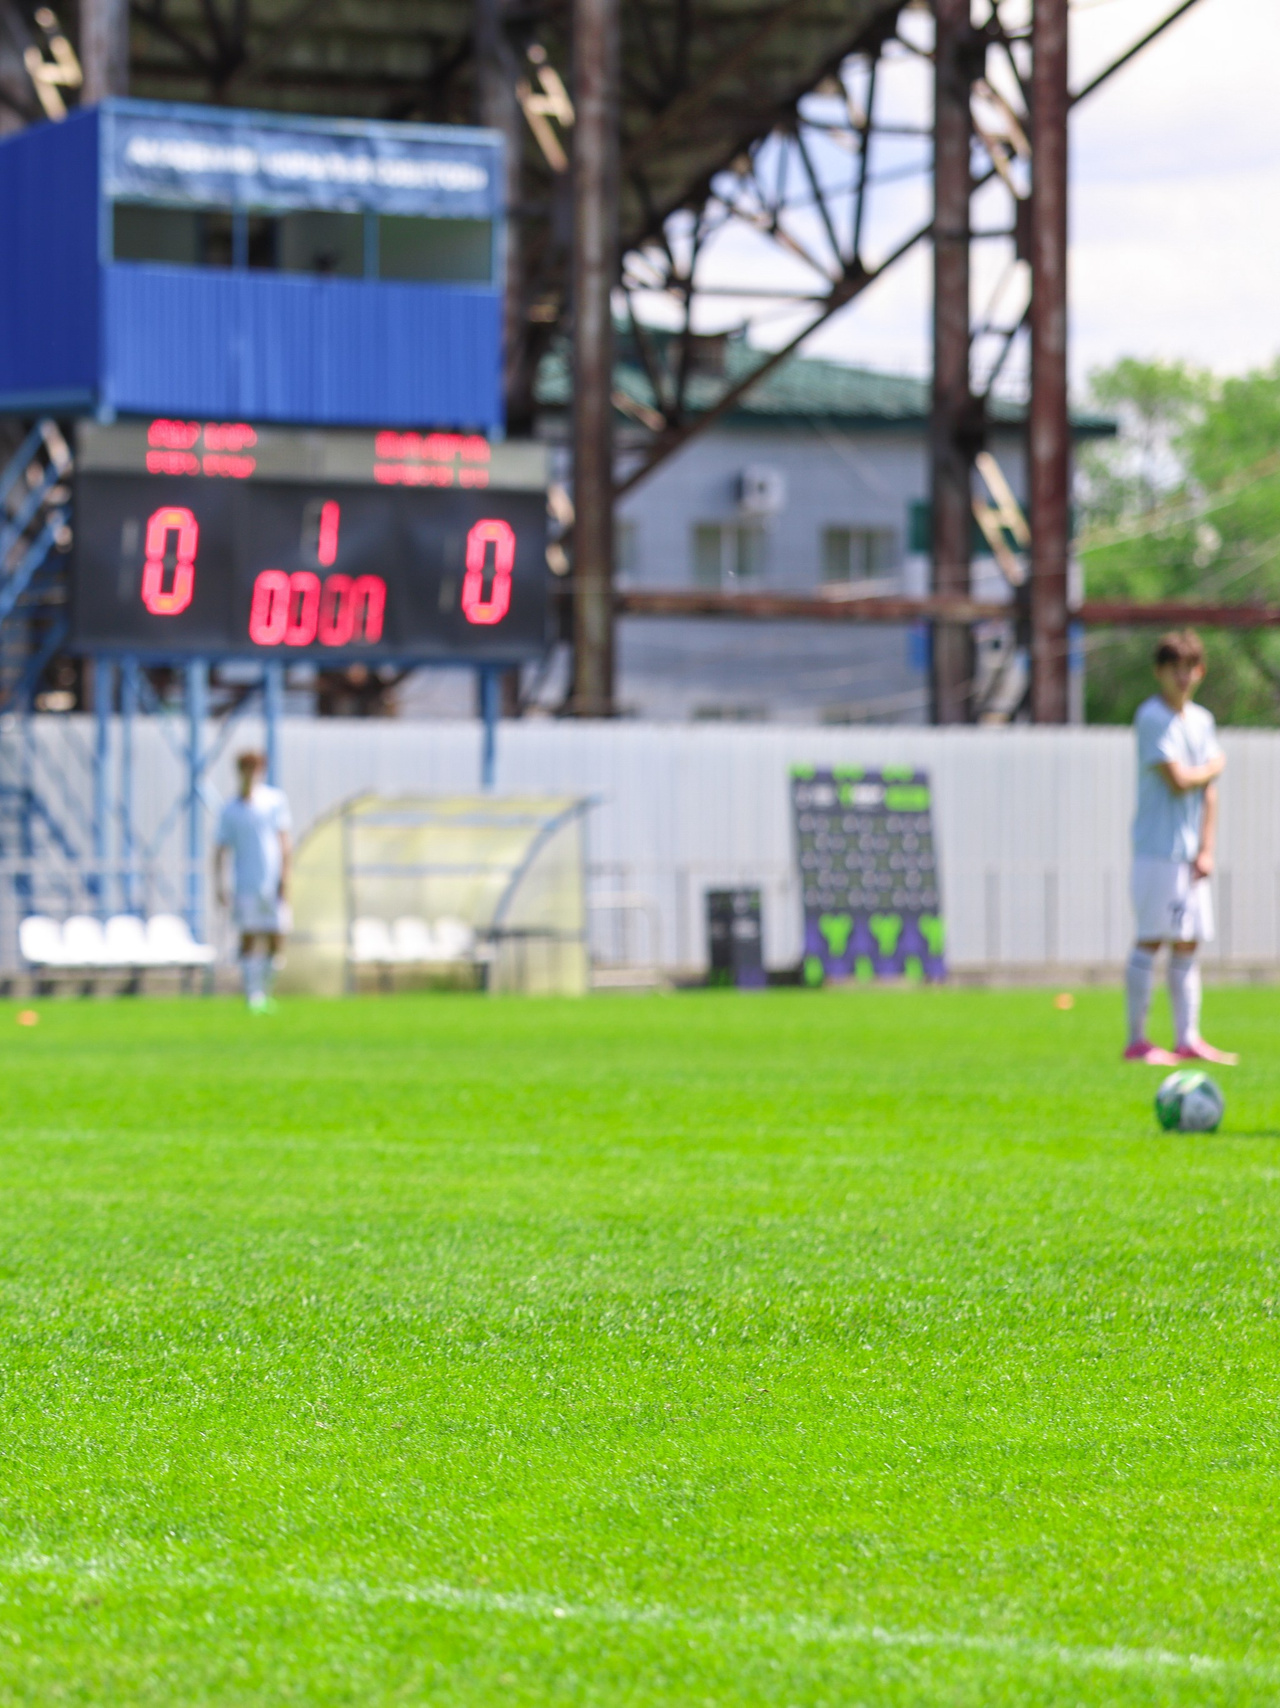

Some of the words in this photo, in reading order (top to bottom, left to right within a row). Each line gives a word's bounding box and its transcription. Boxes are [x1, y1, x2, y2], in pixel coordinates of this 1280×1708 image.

[142, 506, 199, 616] 0
[318, 501, 340, 567] 1
[461, 519, 516, 625] 0
